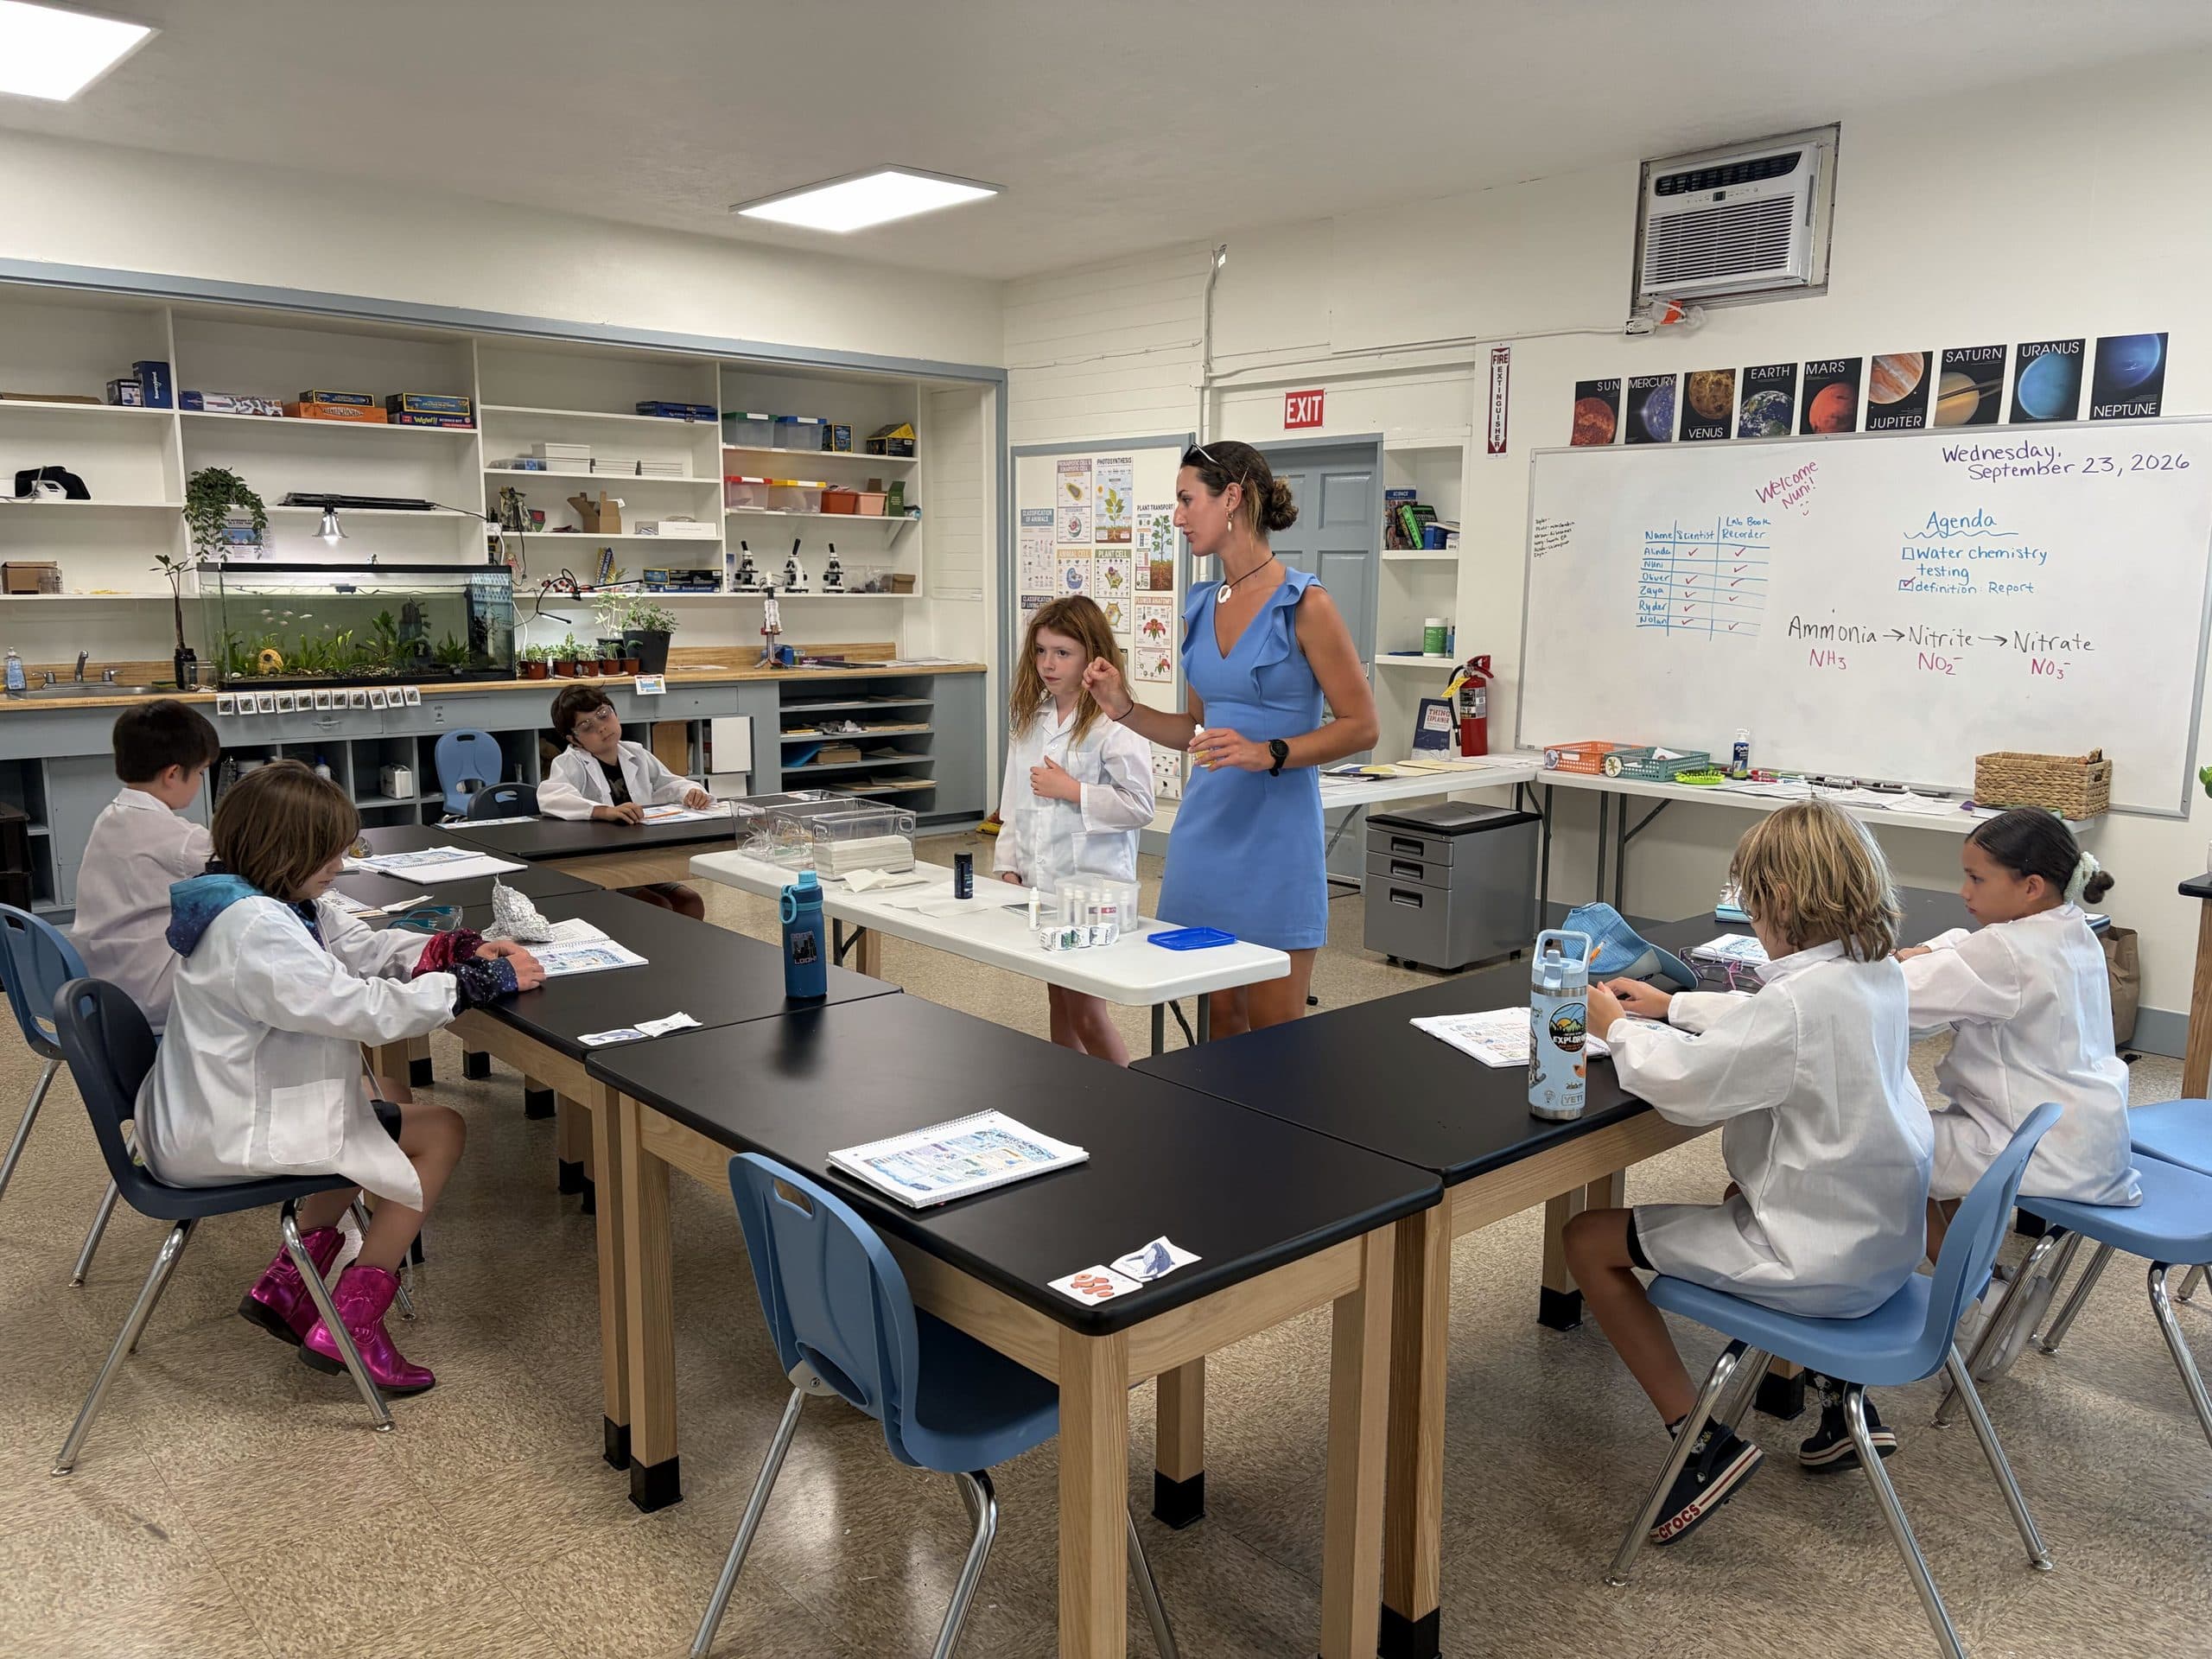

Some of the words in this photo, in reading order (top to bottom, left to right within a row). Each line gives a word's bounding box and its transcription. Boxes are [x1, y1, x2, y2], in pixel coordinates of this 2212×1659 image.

[1945, 347, 2003, 363] SATURN
[2021, 341, 2080, 358] URANUS
[1492, 354, 1508, 365] FIRE
[1751, 365, 1790, 379] EARTH
[1805, 361, 1846, 375] MARS
[1597, 380, 1620, 391] SUN
[1628, 375, 1676, 389] MERCURY
[1287, 396, 1322, 423] EXIT
[1494, 366, 1503, 448] EXTINGUISHER
[2094, 402, 2157, 417] NEPTUNE
[1870, 416, 1923, 429] JUPITER
[1688, 427, 1724, 439] VENUS
[1967, 461, 2075, 484] September
[2131, 454, 2190, 471] 2026
[1755, 461, 1819, 504] Welcome
[1782, 477, 1816, 509] Nuni!
[1726, 517, 1743, 526] Lab
[1746, 516, 1771, 526] Book
[1926, 508, 1997, 538] Agenda
[1645, 531, 1673, 539] Name
[1677, 530, 1715, 539] Scientist
[1722, 529, 1766, 539] Recorder
[1968, 546, 2048, 566] chemistry
[1643, 572, 1670, 582] Oliver
[1916, 563, 1970, 586] testing
[1640, 585, 1664, 599] Zaya
[1988, 581, 2035, 595] Report
[1639, 600, 1668, 614] Ryder
[1640, 616, 1669, 625] Nolan
[1789, 615, 1877, 642] Ammonia
[1909, 625, 1974, 647] Nitrite
[2013, 630, 2095, 652] Nitrate
[1428, 709, 1450, 717] THING
